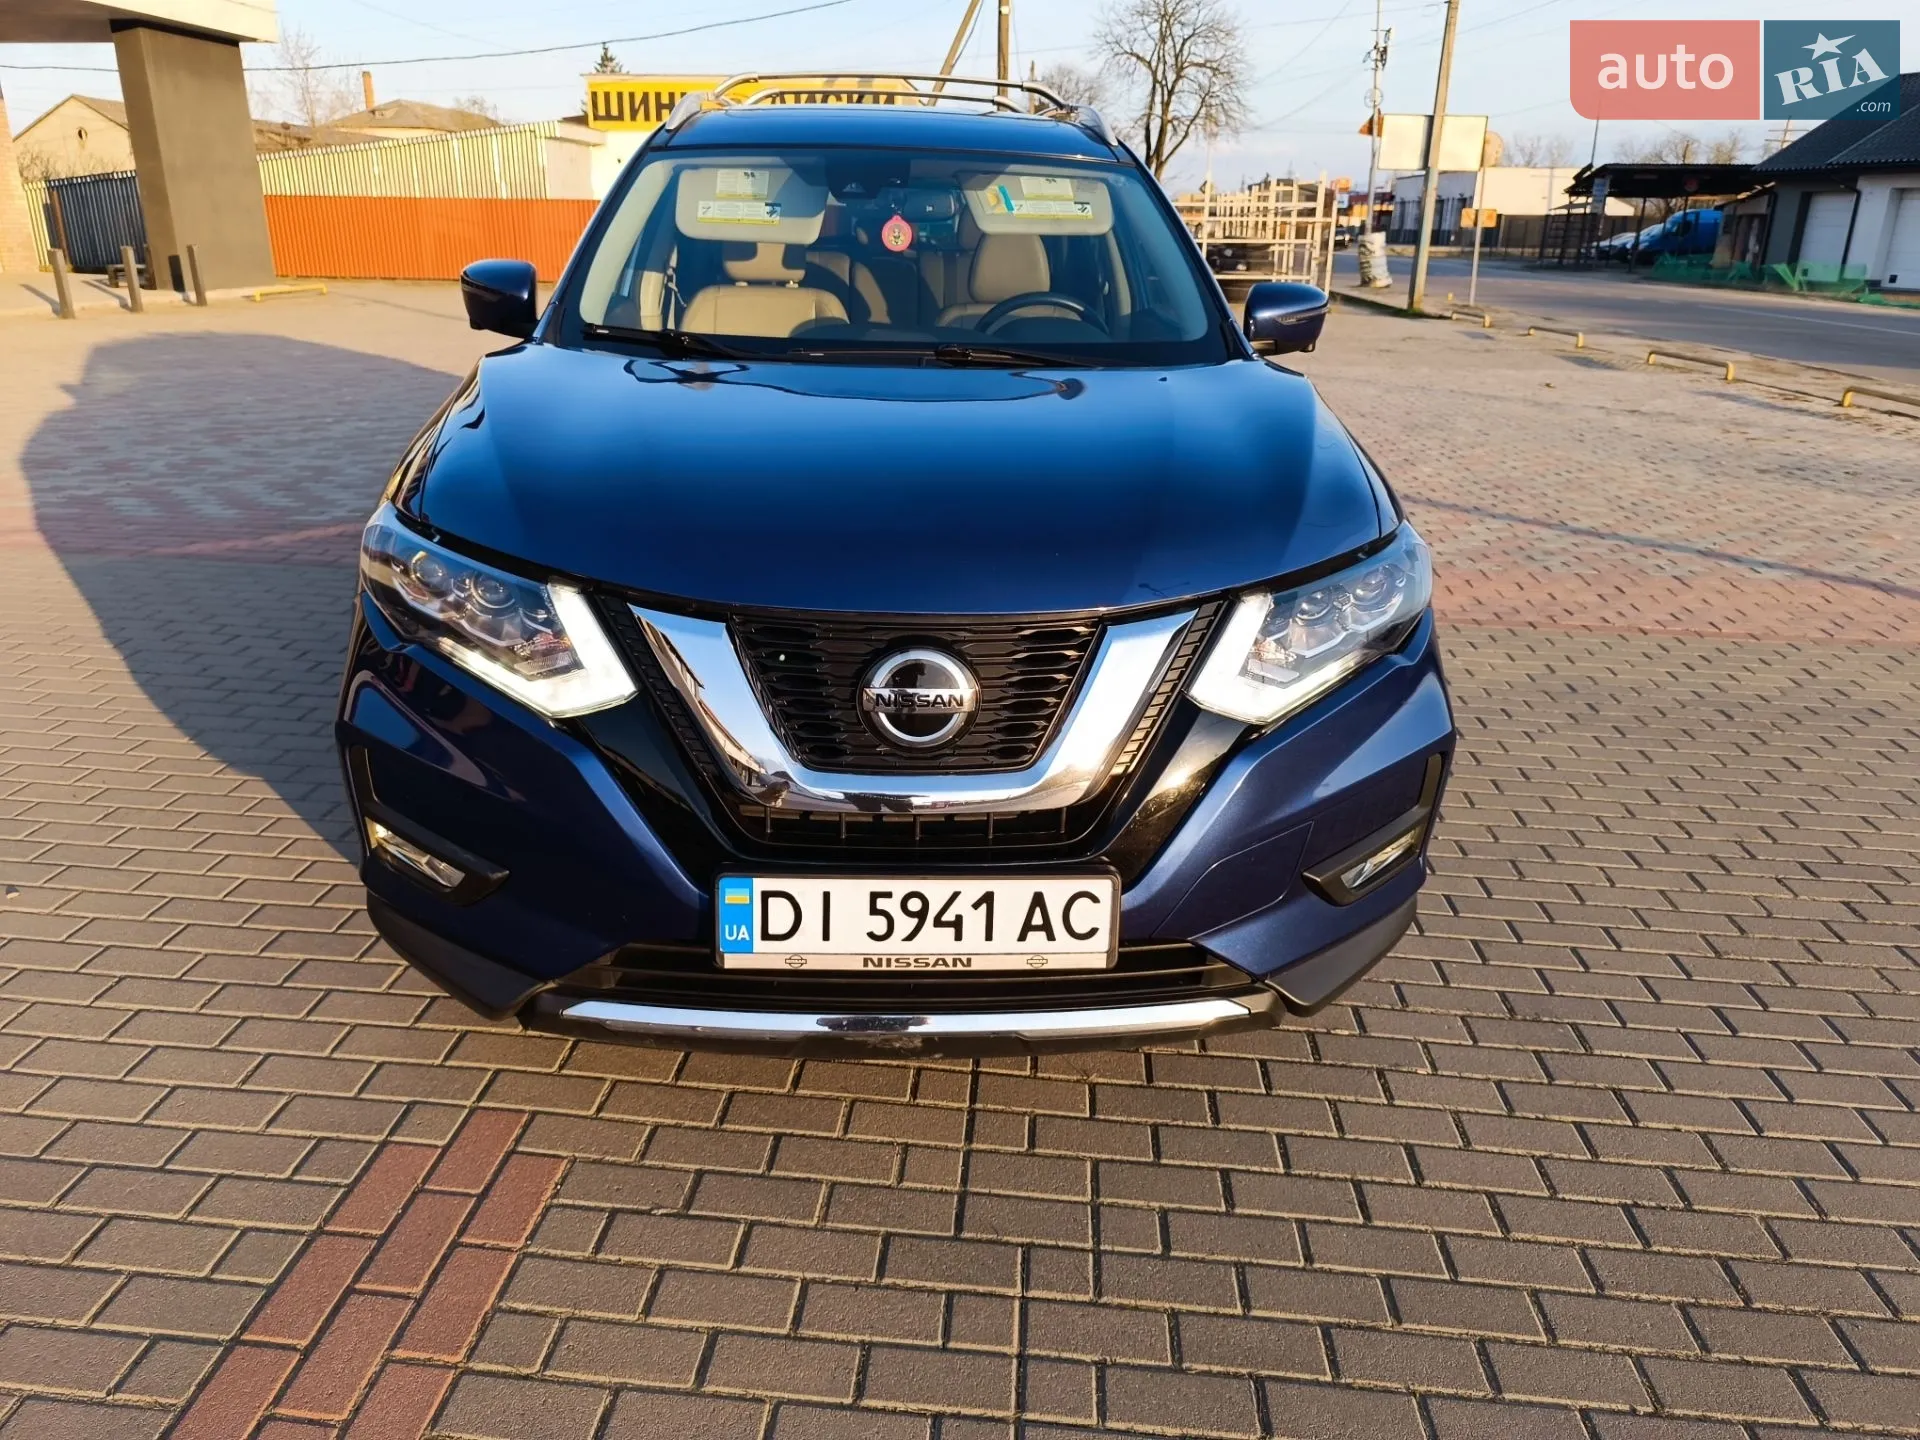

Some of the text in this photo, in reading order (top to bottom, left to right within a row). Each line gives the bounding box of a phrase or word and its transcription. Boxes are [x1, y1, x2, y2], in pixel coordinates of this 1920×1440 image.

[591, 91, 687, 122] ШИН
[875, 692, 964, 708] NISSAN
[760, 890, 1100, 942] DI 5941 AC
[725, 925, 750, 941] UA
[862, 957, 972, 968] NISSAN
